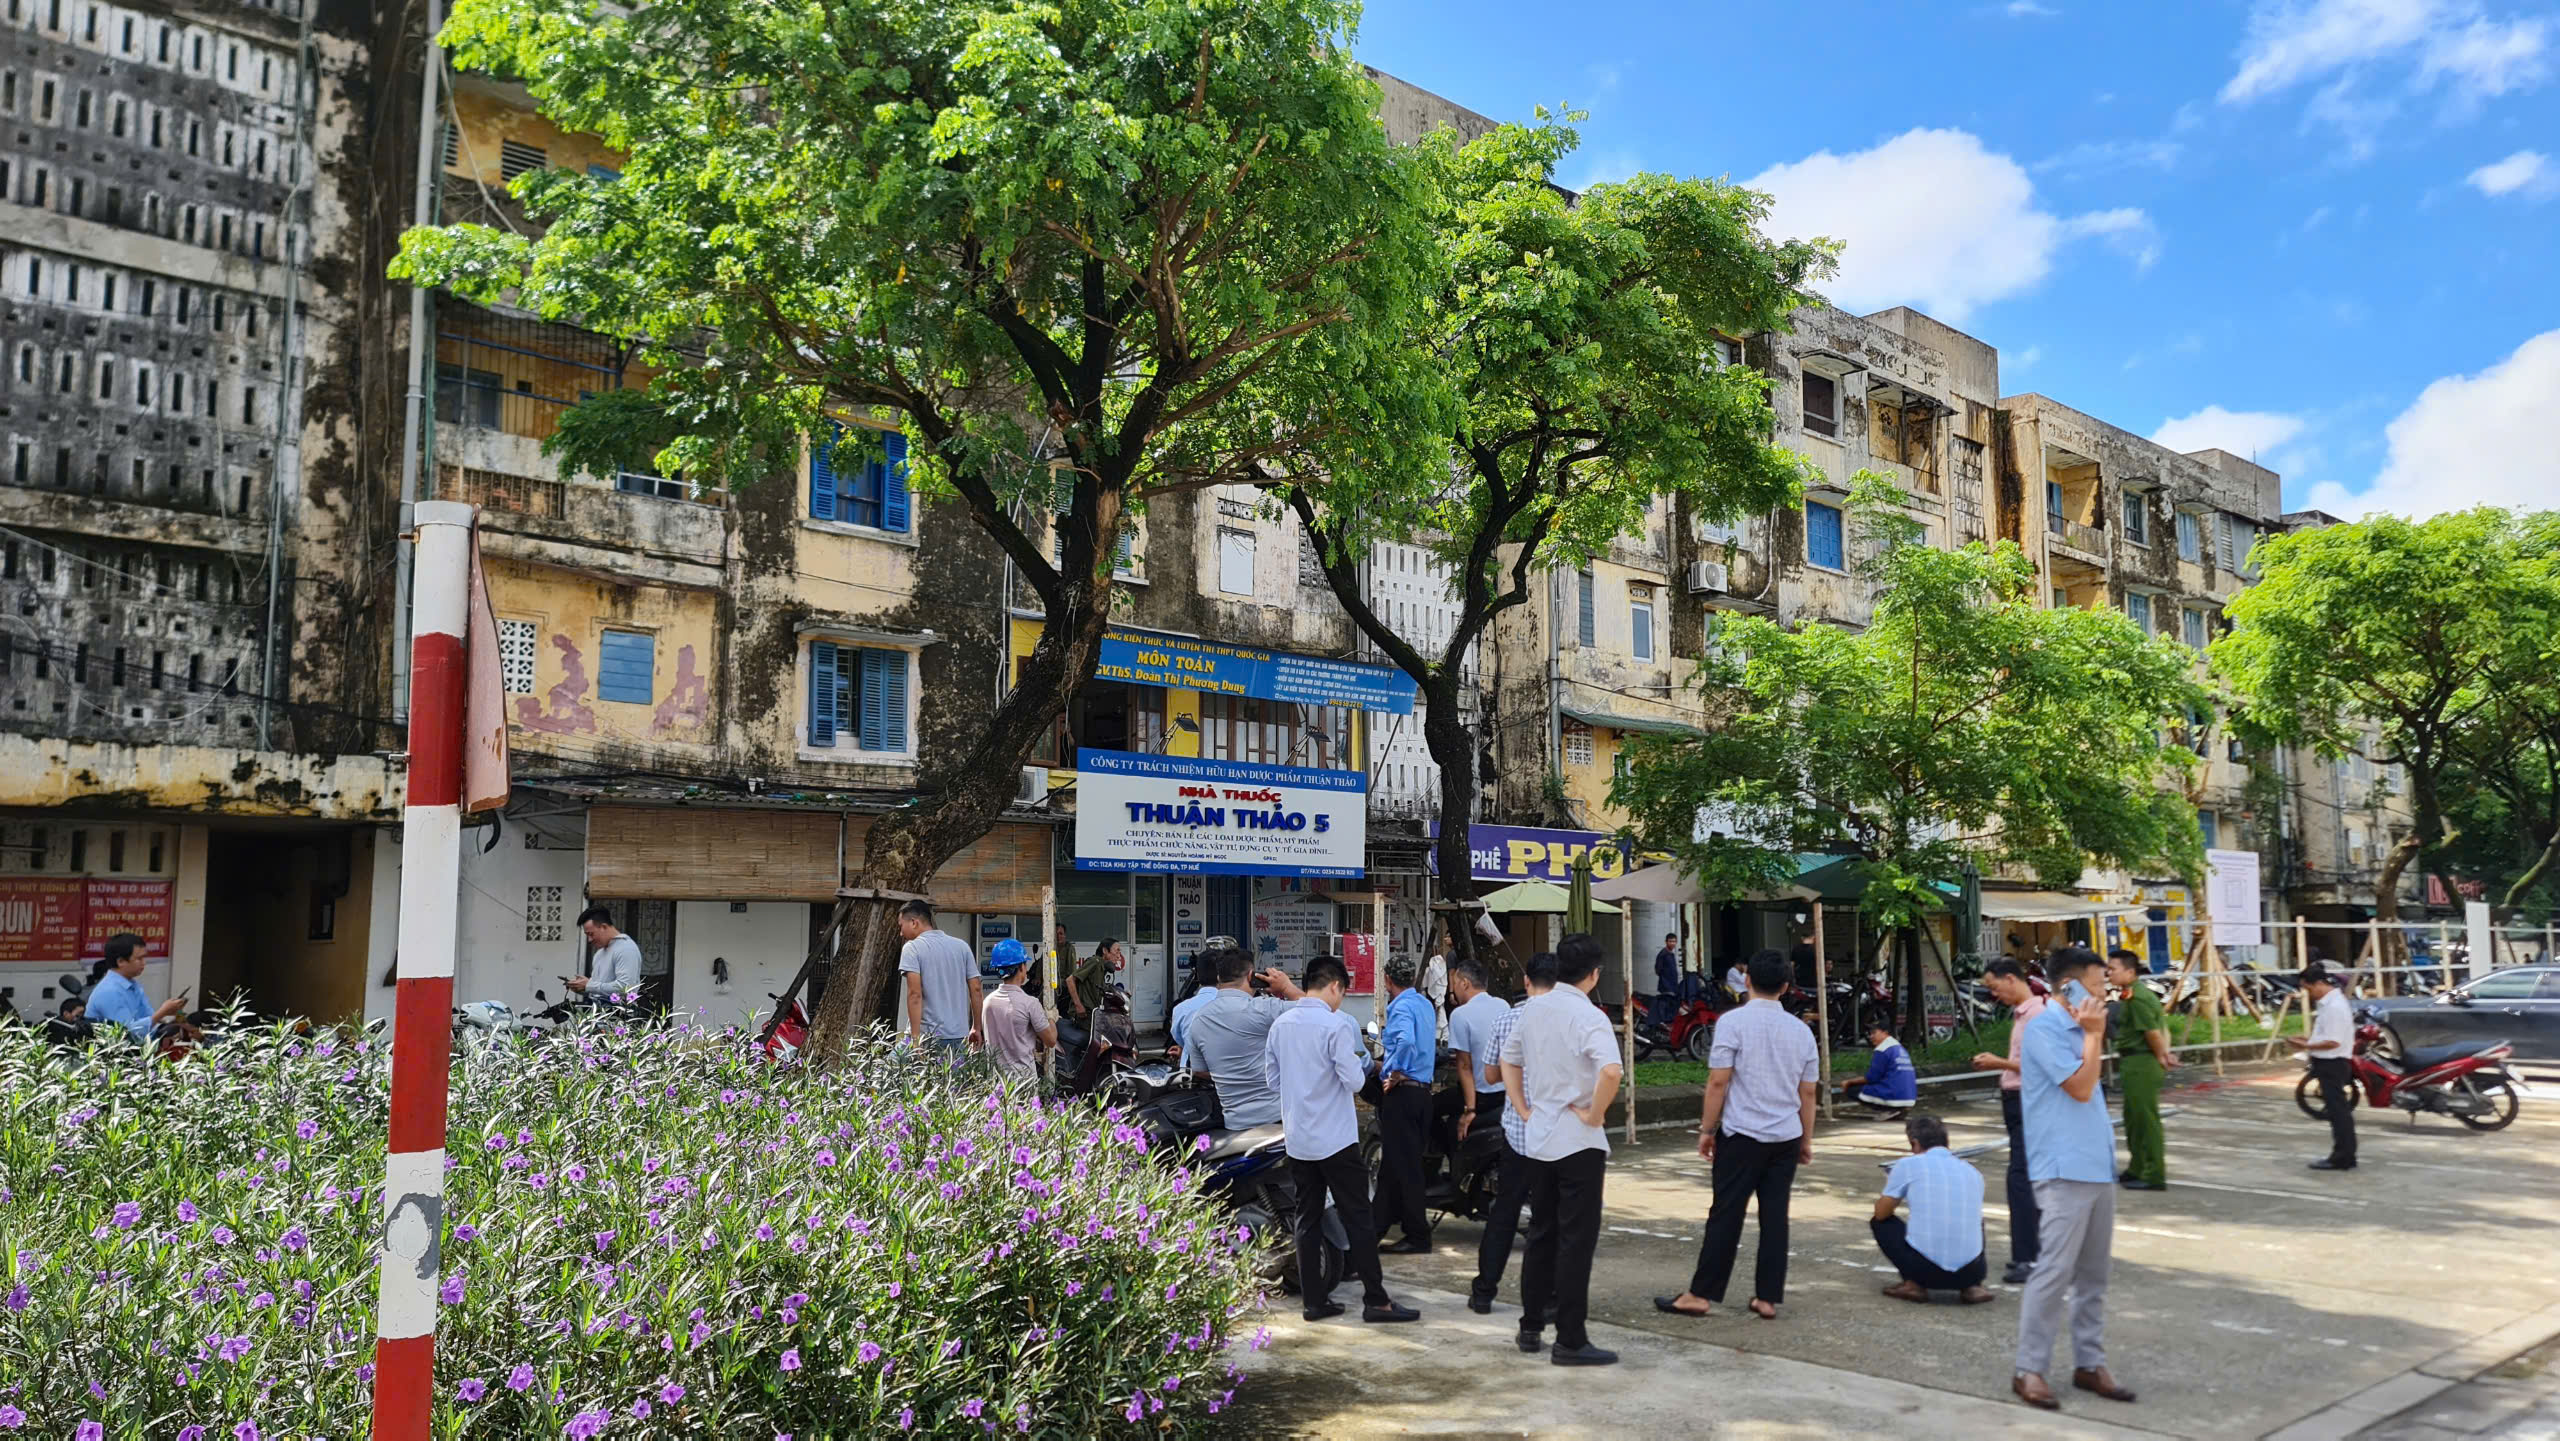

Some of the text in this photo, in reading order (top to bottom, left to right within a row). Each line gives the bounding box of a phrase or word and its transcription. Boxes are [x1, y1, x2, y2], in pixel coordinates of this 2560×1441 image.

[1137, 649, 1216, 673] MÔN TOÁN
[1257, 653, 1270, 662] GIA
[1164, 671, 1180, 687] Thị
[1183, 675, 1219, 692] Phương
[1221, 680, 1246, 695] Dung
[1090, 755, 1357, 787] CÔNG TY TRÁCH NHIỆM HỮU HẠN DƯỢC PHẨM THUẬN THẢO
[1178, 784, 1282, 803] NHÀ THUỐC
[1125, 800, 1330, 833] THUẬN THẢO 5
[1125, 829, 1164, 838] CHUYÊN:
[1165, 831, 1182, 839] BÁN
[1196, 832, 1214, 840] CÁC
[1235, 834, 1257, 843] DƯỢC
[1284, 836, 1296, 844] MỸ
[1297, 836, 1320, 845] PHẨM
[1107, 838, 1131, 847] THỰC
[1132, 838, 1158, 848] PHẨM
[1160, 840, 1184, 848] CHỨC
[1210, 842, 1223, 851] VẬT
[1282, 844, 1293, 853] TẾ
[1127, 862, 1139, 870] TẬP
[1140, 861, 1151, 869] THỂ
[1188, 862, 1200, 870] HUẾ
[1471, 846, 1501, 871] PHÊ
[1177, 876, 1201, 890] THUẬN
[1178, 890, 1201, 905] THẢO
[88, 927, 104, 937] 15
